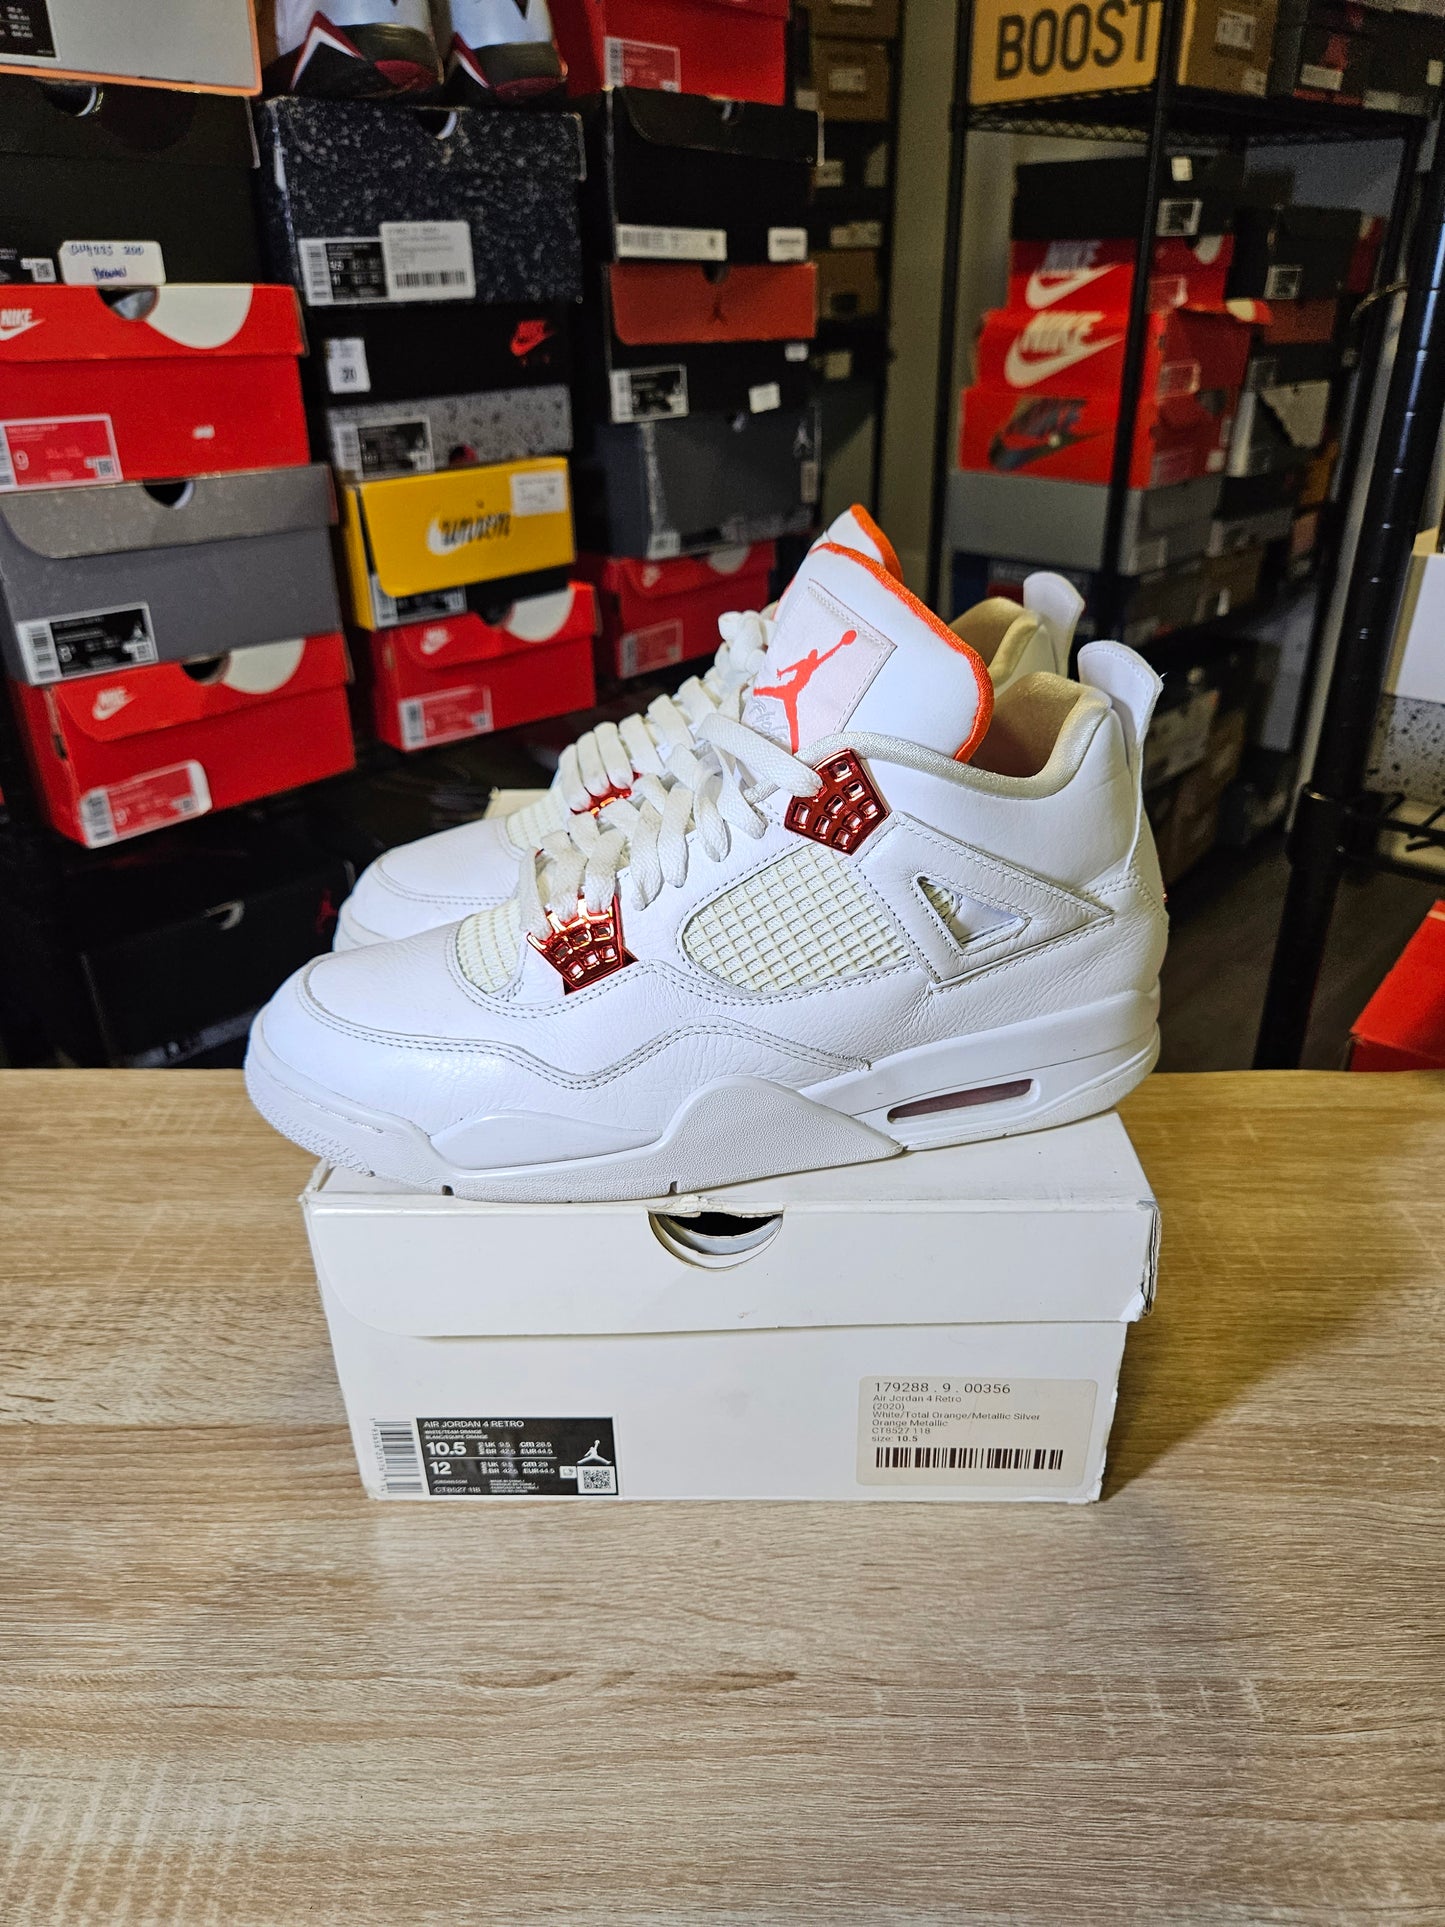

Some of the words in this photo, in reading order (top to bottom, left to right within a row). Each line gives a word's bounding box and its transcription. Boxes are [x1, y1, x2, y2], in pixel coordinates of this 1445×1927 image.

[996, 0, 1154, 81] BOOST
[1, 308, 33, 325] NIKE
[1020, 311, 1106, 354] NIKE
[874, 1382, 929, 1393] 179288
[942, 1382, 951, 1393] 9
[964, 1383, 1011, 1394] 00356
[873, 1394, 886, 1402] Air
[889, 1394, 924, 1402] Jordan
[935, 1395, 962, 1403] Retro
[872, 1402, 905, 1411] (2020)
[872, 1411, 930, 1419] White/Total
[932, 1411, 1011, 1420] Orange/Metallic
[1013, 1412, 1040, 1420] Silver
[423, 1420, 440, 1428] AIR
[441, 1420, 481, 1428] JORDAN
[482, 1420, 489, 1428] 4
[491, 1420, 525, 1428] RETRO
[872, 1419, 907, 1427] Orange
[909, 1419, 949, 1427] Metallic
[871, 1427, 910, 1435] CT8527
[914, 1427, 931, 1435] 118
[897, 1435, 918, 1443] 10.5
[426, 1441, 467, 1456] 10.5
[430, 1461, 452, 1475] 12
